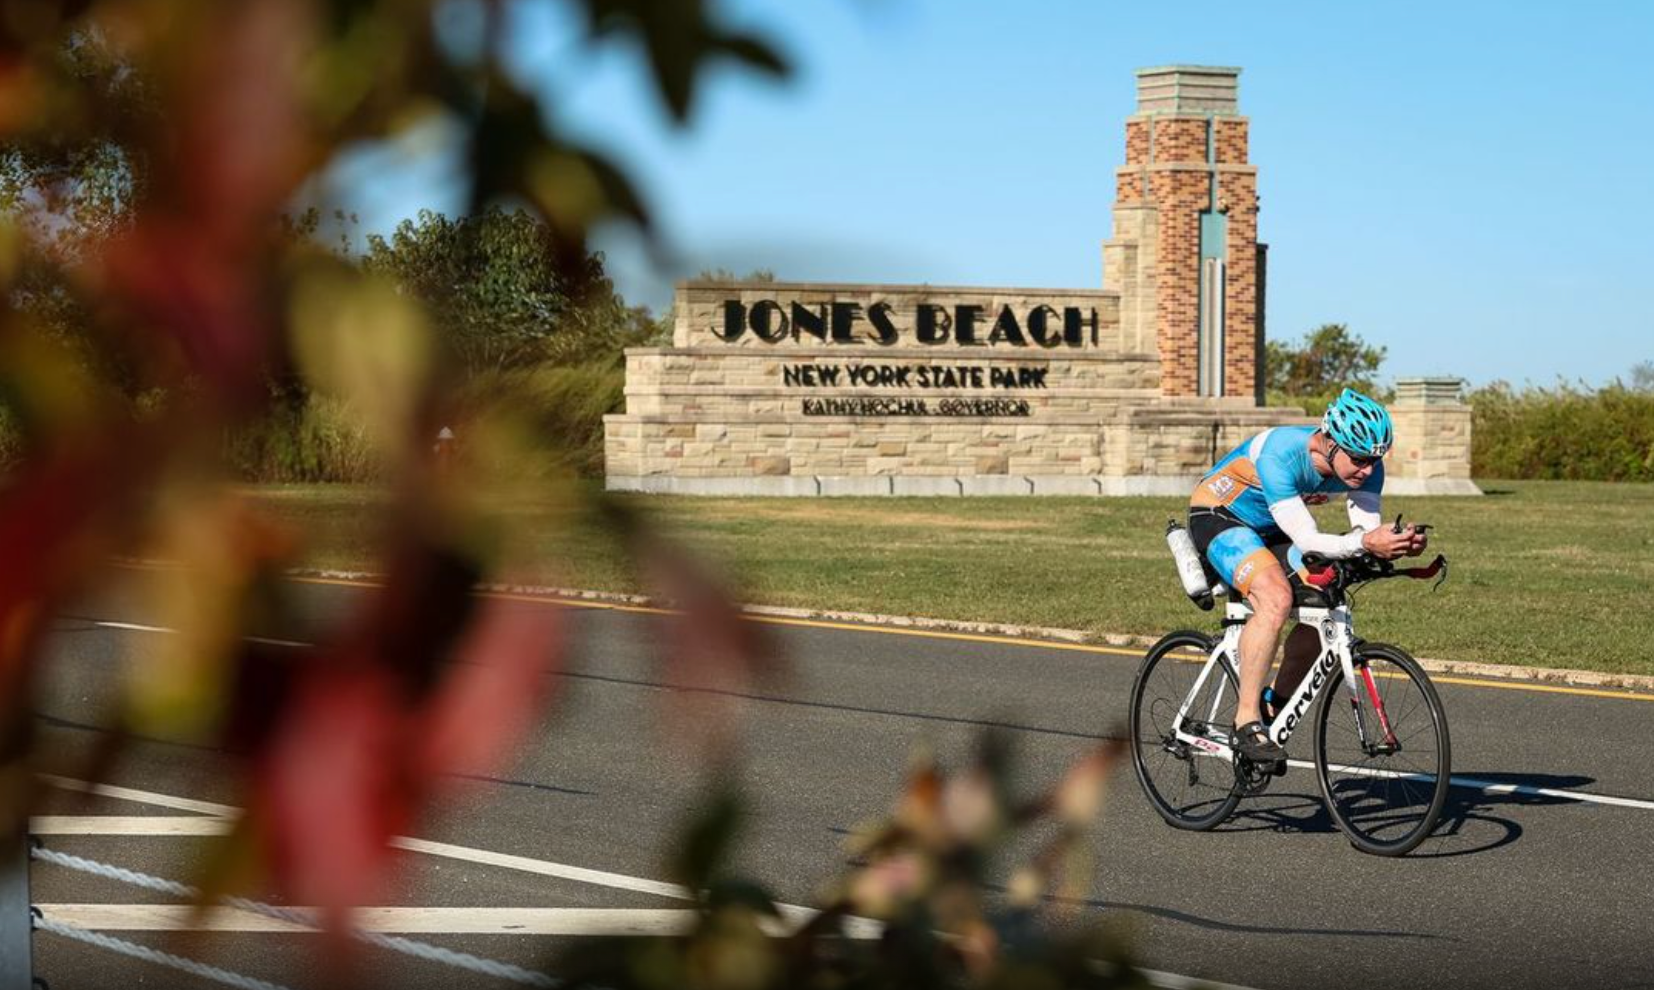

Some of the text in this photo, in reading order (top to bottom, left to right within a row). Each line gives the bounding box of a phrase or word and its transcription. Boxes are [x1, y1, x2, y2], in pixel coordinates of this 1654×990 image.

[711, 299, 1099, 348] JONES BEACH
[783, 364, 1048, 389] NEW YORK STATE PARK
[803, 398, 859, 415] KATHY
[939, 399, 1030, 416] GOVERNOR
